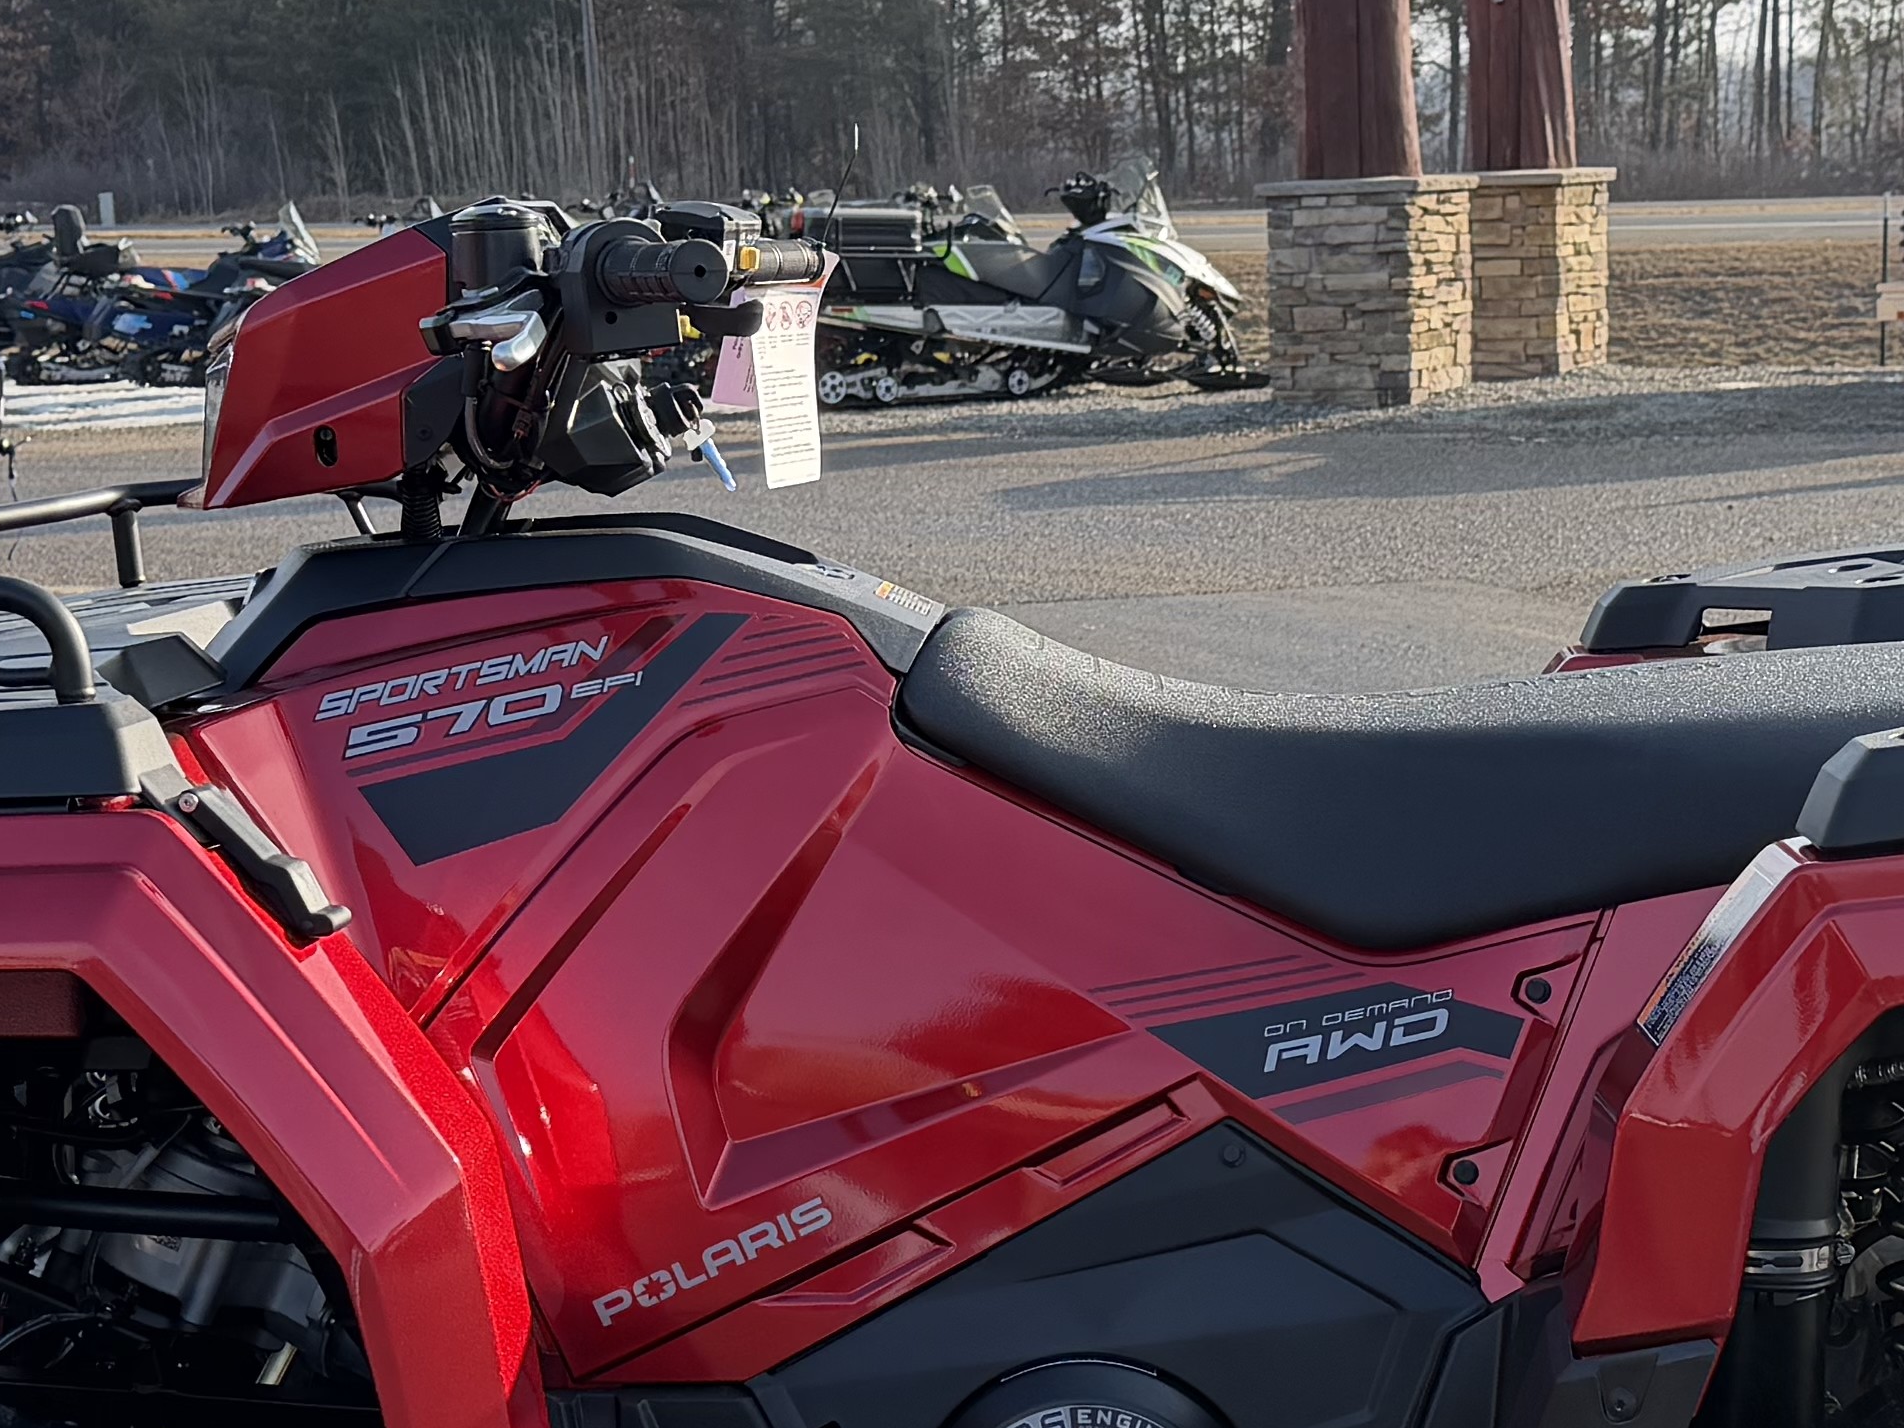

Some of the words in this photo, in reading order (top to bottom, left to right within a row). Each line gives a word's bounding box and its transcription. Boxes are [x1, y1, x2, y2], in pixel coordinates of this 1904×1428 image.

[314, 635, 610, 722] SPORTSMAN
[344, 684, 564, 759] 570
[570, 670, 643, 700] EFI
[1263, 1019, 1308, 1038] ON
[1320, 988, 1453, 1026] DEMAND
[1263, 1008, 1450, 1073] AWD
[592, 1197, 831, 1326] POLARIS
